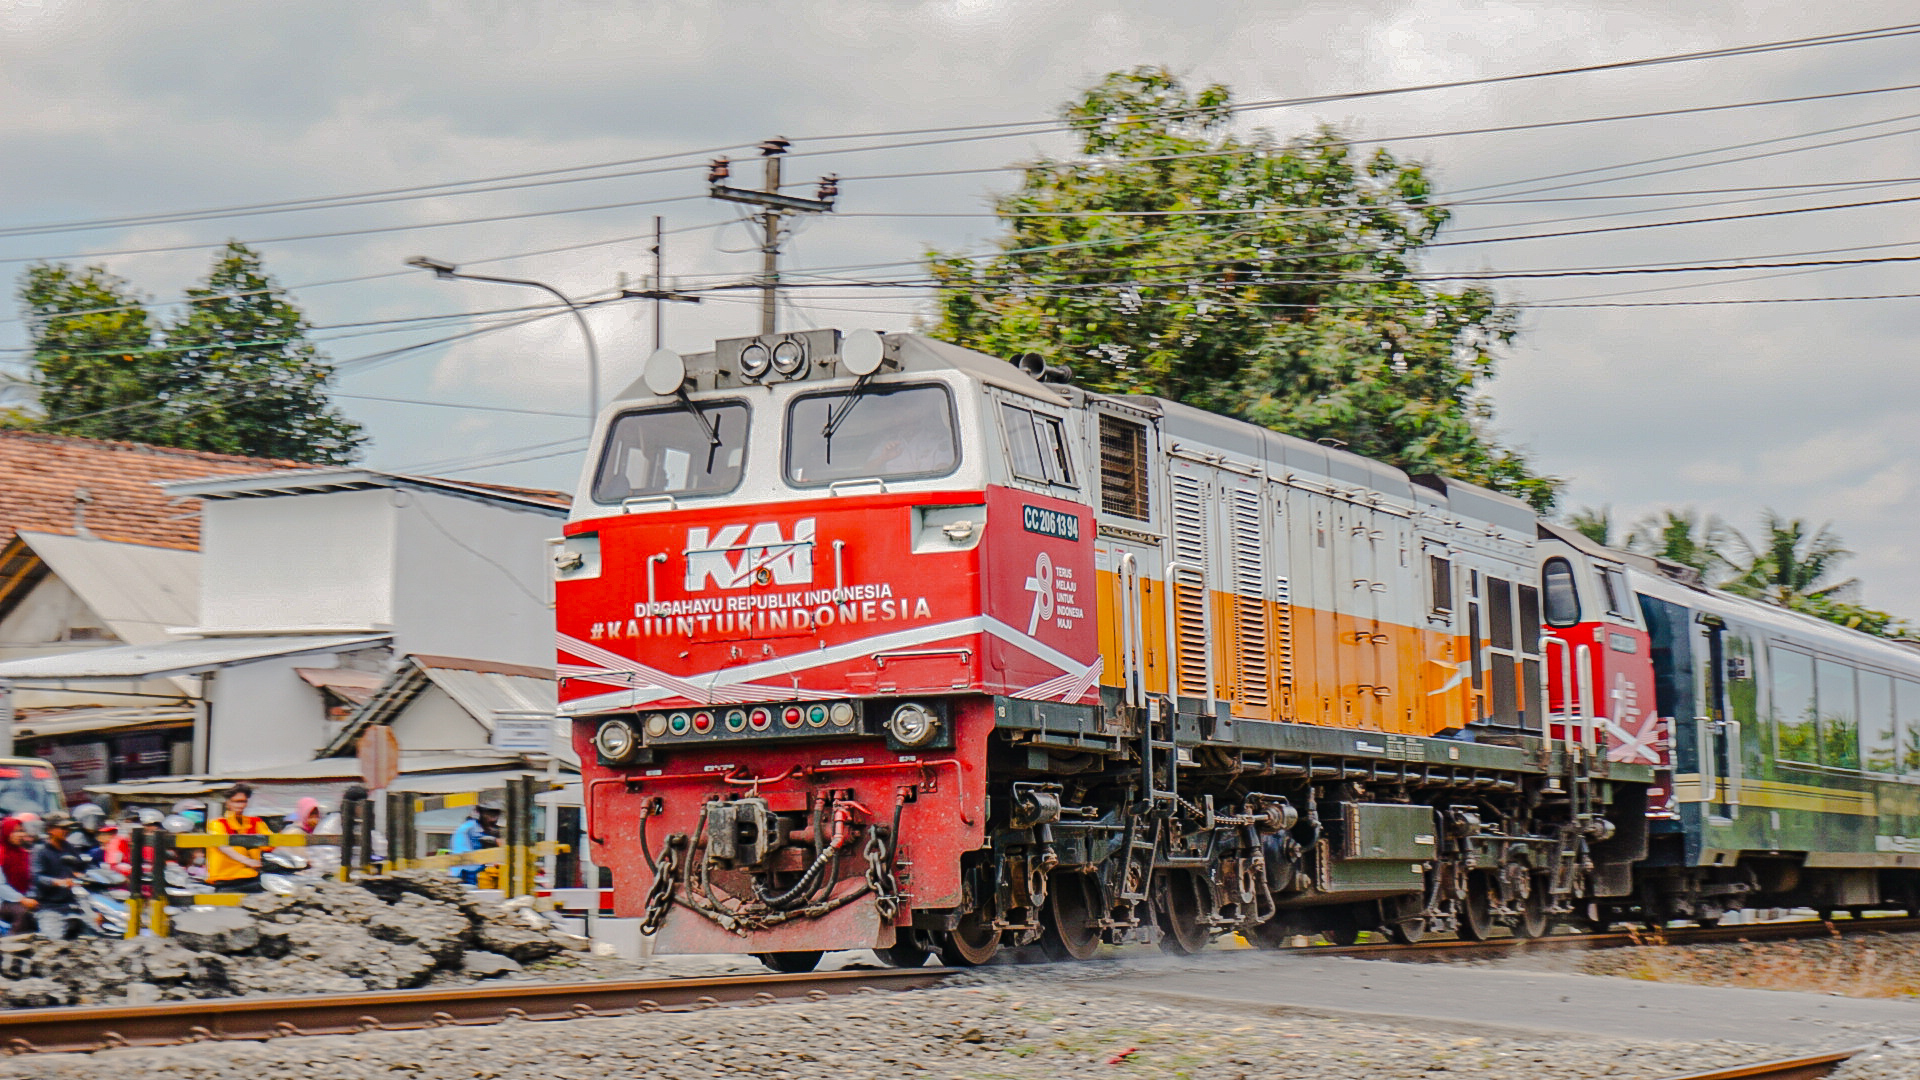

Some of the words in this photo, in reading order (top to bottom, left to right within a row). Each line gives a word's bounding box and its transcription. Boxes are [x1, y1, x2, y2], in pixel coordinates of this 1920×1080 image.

[1024, 506, 1039, 530] CC
[1040, 510, 1056, 533] 206
[1057, 514, 1066, 536] 13
[1067, 518, 1078, 539] 94
[684, 517, 817, 592] KAI
[1055, 566, 1073, 579] TERUS
[1025, 552, 1054, 637] 78
[1055, 580, 1077, 592] MELAJU
[634, 598, 723, 619] DIRGAHAYU
[726, 592, 803, 612] REPUBLIK
[805, 583, 893, 607] INDONESIA
[1056, 593, 1074, 605] UNTUK
[590, 597, 932, 641] #KAIUNTUKINDONESIA
[1056, 605, 1084, 619] INDONESIA
[1057, 618, 1073, 630] MAJU
